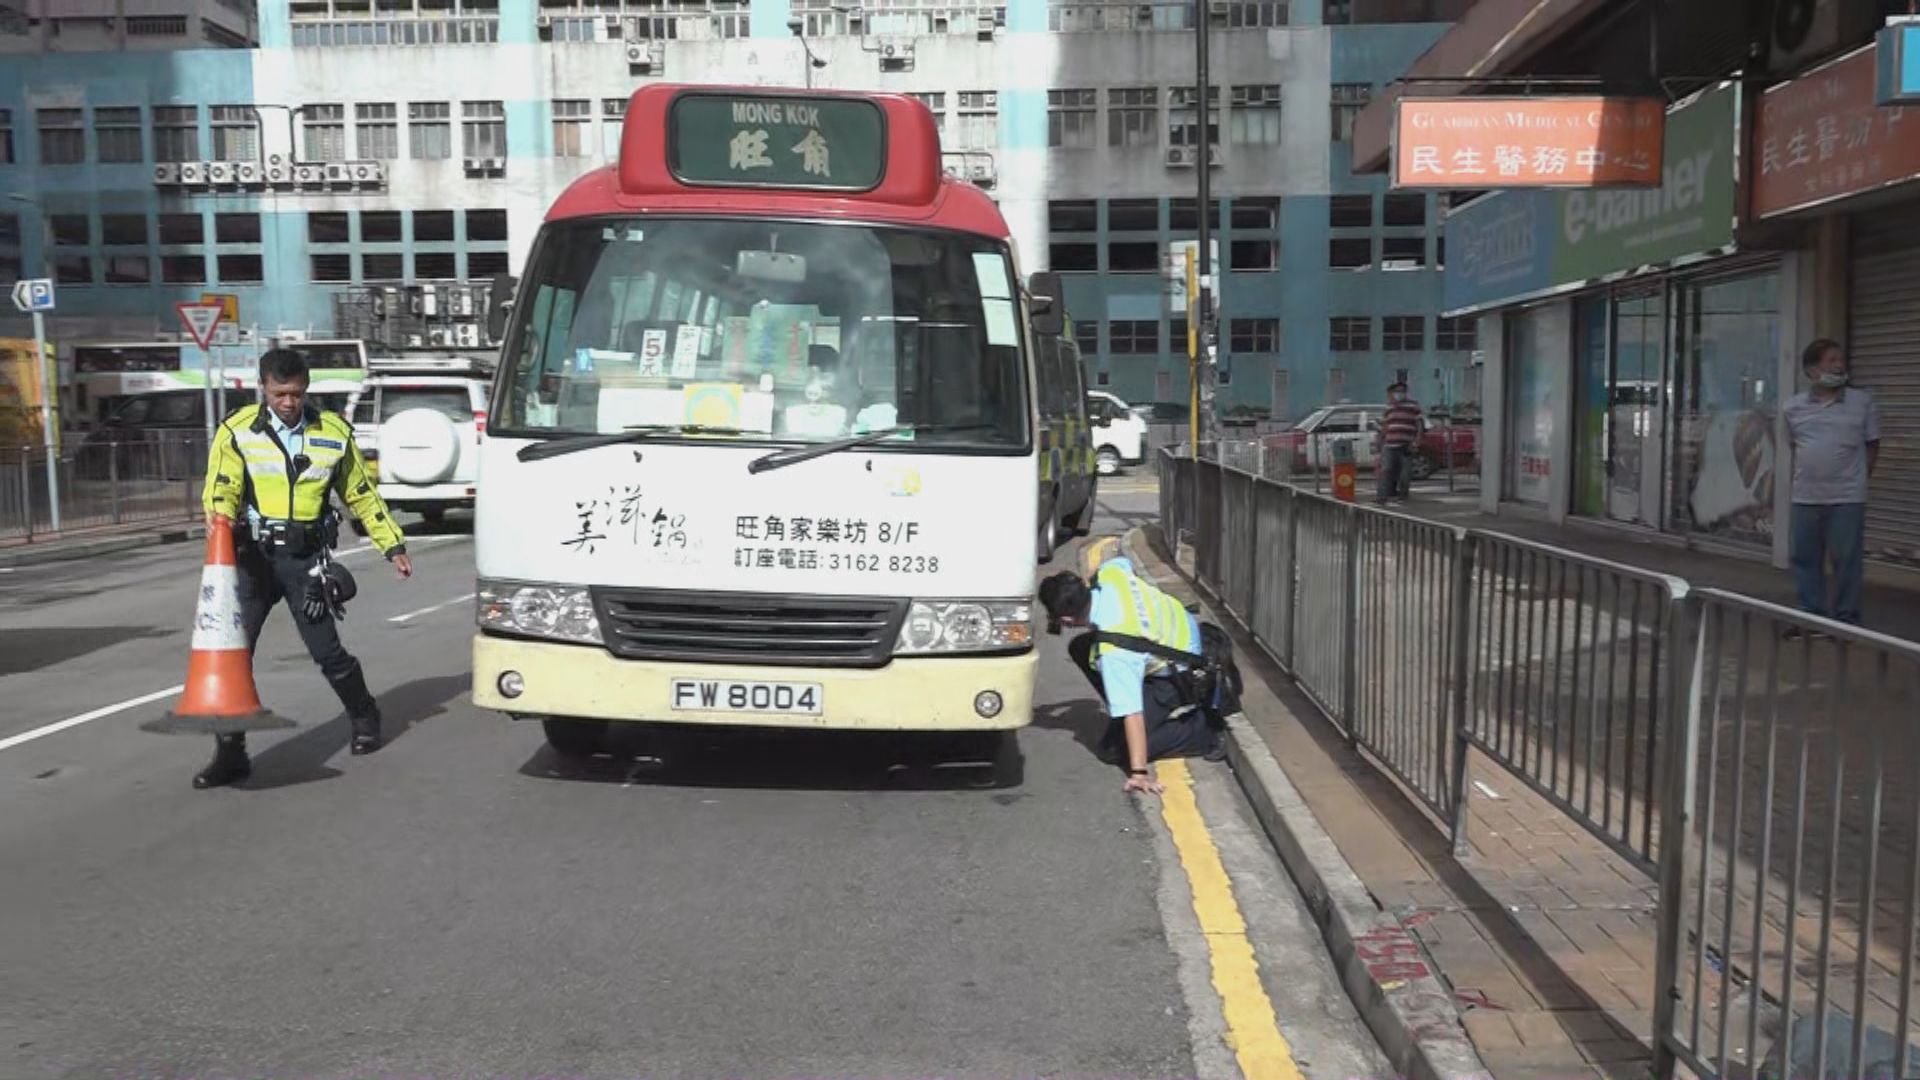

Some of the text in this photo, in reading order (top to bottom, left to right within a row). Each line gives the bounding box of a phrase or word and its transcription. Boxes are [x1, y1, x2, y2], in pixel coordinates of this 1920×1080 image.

[732, 102, 820, 126] MONG KOK
[730, 130, 831, 178] 旺角
[1411, 144, 1650, 176] 民生醫務中心
[735, 516, 920, 545] 旺角家樂坊 8/F
[888, 556, 939, 573] 8238
[676, 682, 816, 711] FW 8004
